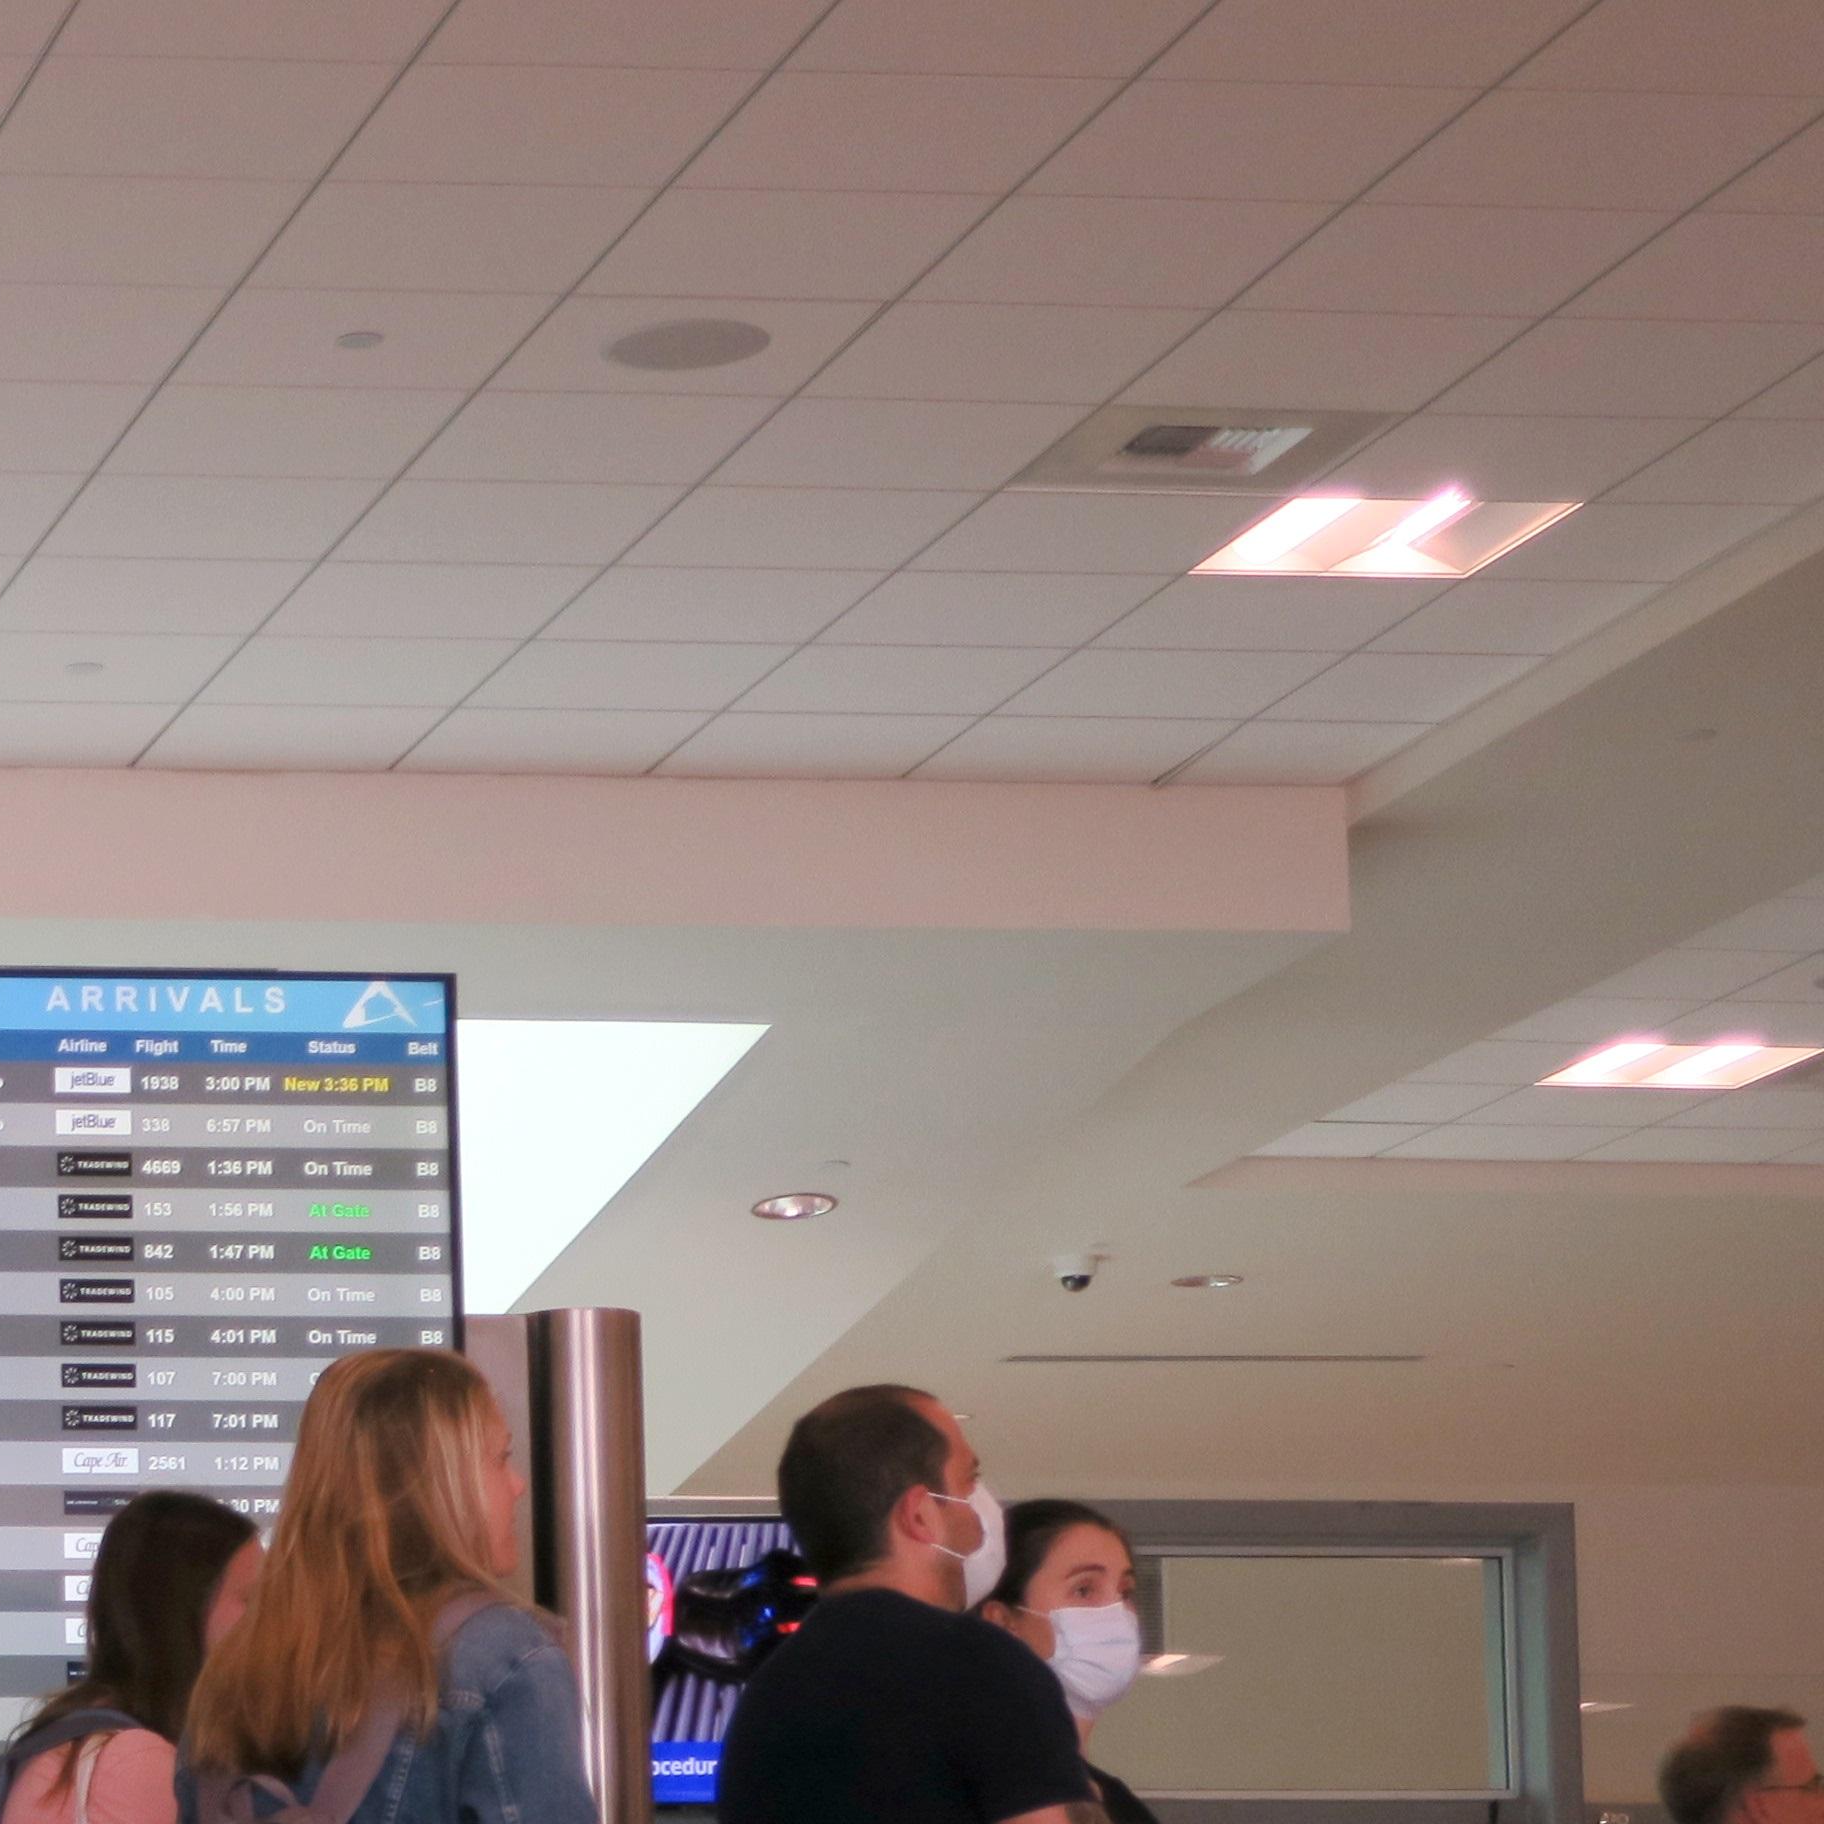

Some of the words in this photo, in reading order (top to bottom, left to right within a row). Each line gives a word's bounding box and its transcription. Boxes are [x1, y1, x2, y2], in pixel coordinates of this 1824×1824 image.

[46, 985, 287, 1014] ARRIVALS
[58, 1039, 107, 1052] Airline
[135, 1039, 178, 1056] Flight
[210, 1039, 247, 1053] Time
[308, 1040, 356, 1054] Status
[408, 1042, 438, 1055] Belt
[70, 1072, 115, 1090] jetBlue
[141, 1076, 179, 1090] 1938
[205, 1076, 240, 1091] 3:00
[244, 1076, 270, 1091] PM
[284, 1077, 319, 1091] New
[324, 1077, 359, 1092] 3:36
[362, 1078, 389, 1092] PM
[414, 1078, 437, 1092] B8
[77, 1161, 129, 1169] TRADEWIND
[142, 1160, 181, 1174] 4669
[208, 1160, 242, 1175] 1:36
[246, 1161, 272, 1175] PM
[304, 1161, 328, 1175] On
[332, 1161, 372, 1176] Time
[144, 1244, 173, 1259] 842
[209, 1244, 244, 1259] 1:47
[248, 1245, 274, 1259] PM
[309, 1246, 328, 1260] At
[331, 1244, 372, 1260] Gate
[419, 1246, 441, 1260] B8
[148, 1413, 176, 1428] 117
[213, 1414, 246, 1428] 7:01
[252, 1414, 278, 1428] PM
[148, 1456, 185, 1470] 2561
[215, 1457, 248, 1470] 1:12
